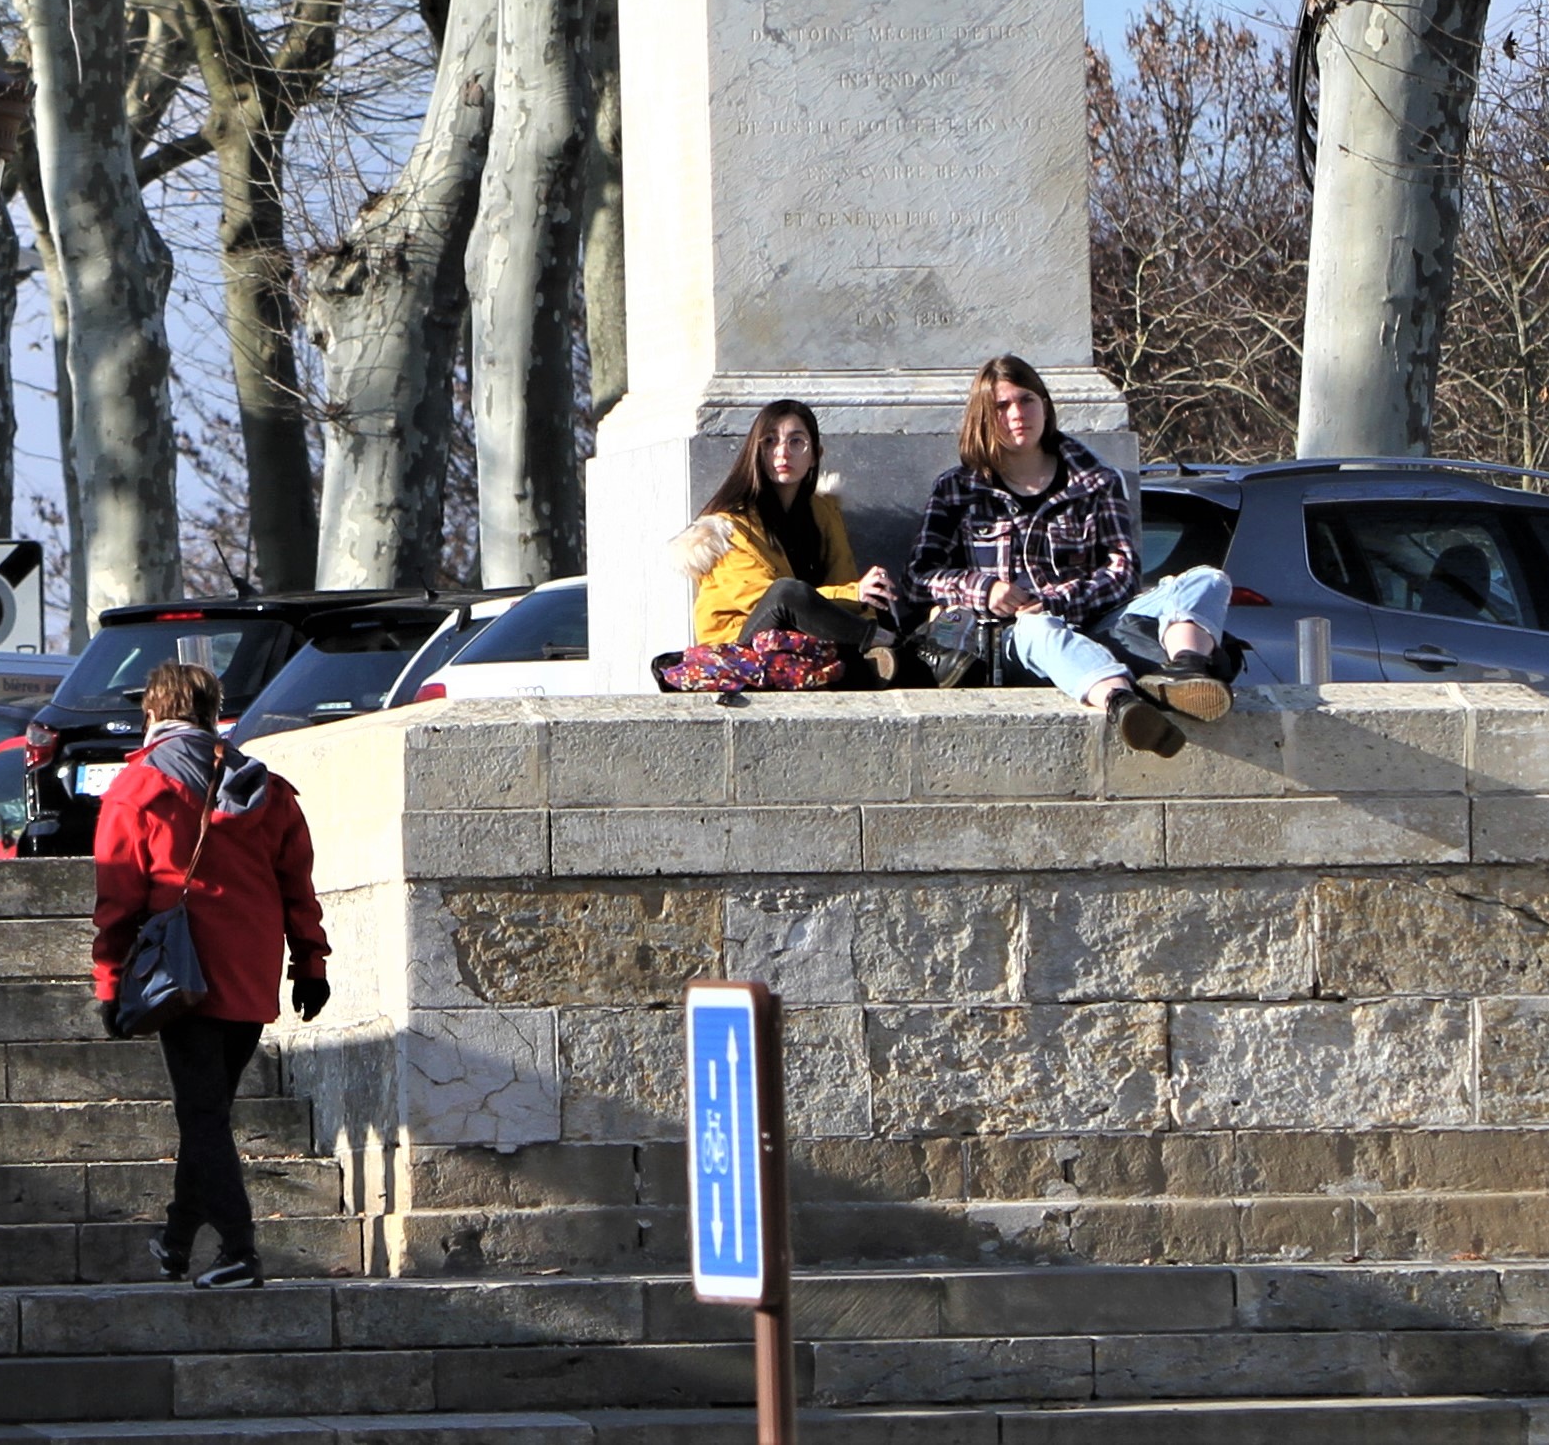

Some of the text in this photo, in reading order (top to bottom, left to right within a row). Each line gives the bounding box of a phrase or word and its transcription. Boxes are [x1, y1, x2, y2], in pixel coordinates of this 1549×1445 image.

[838, 71, 959, 88] INTENDANT
[737, 120, 763, 135] DE
[784, 211, 806, 227] ET
[2, 676, 41, 694] bières
